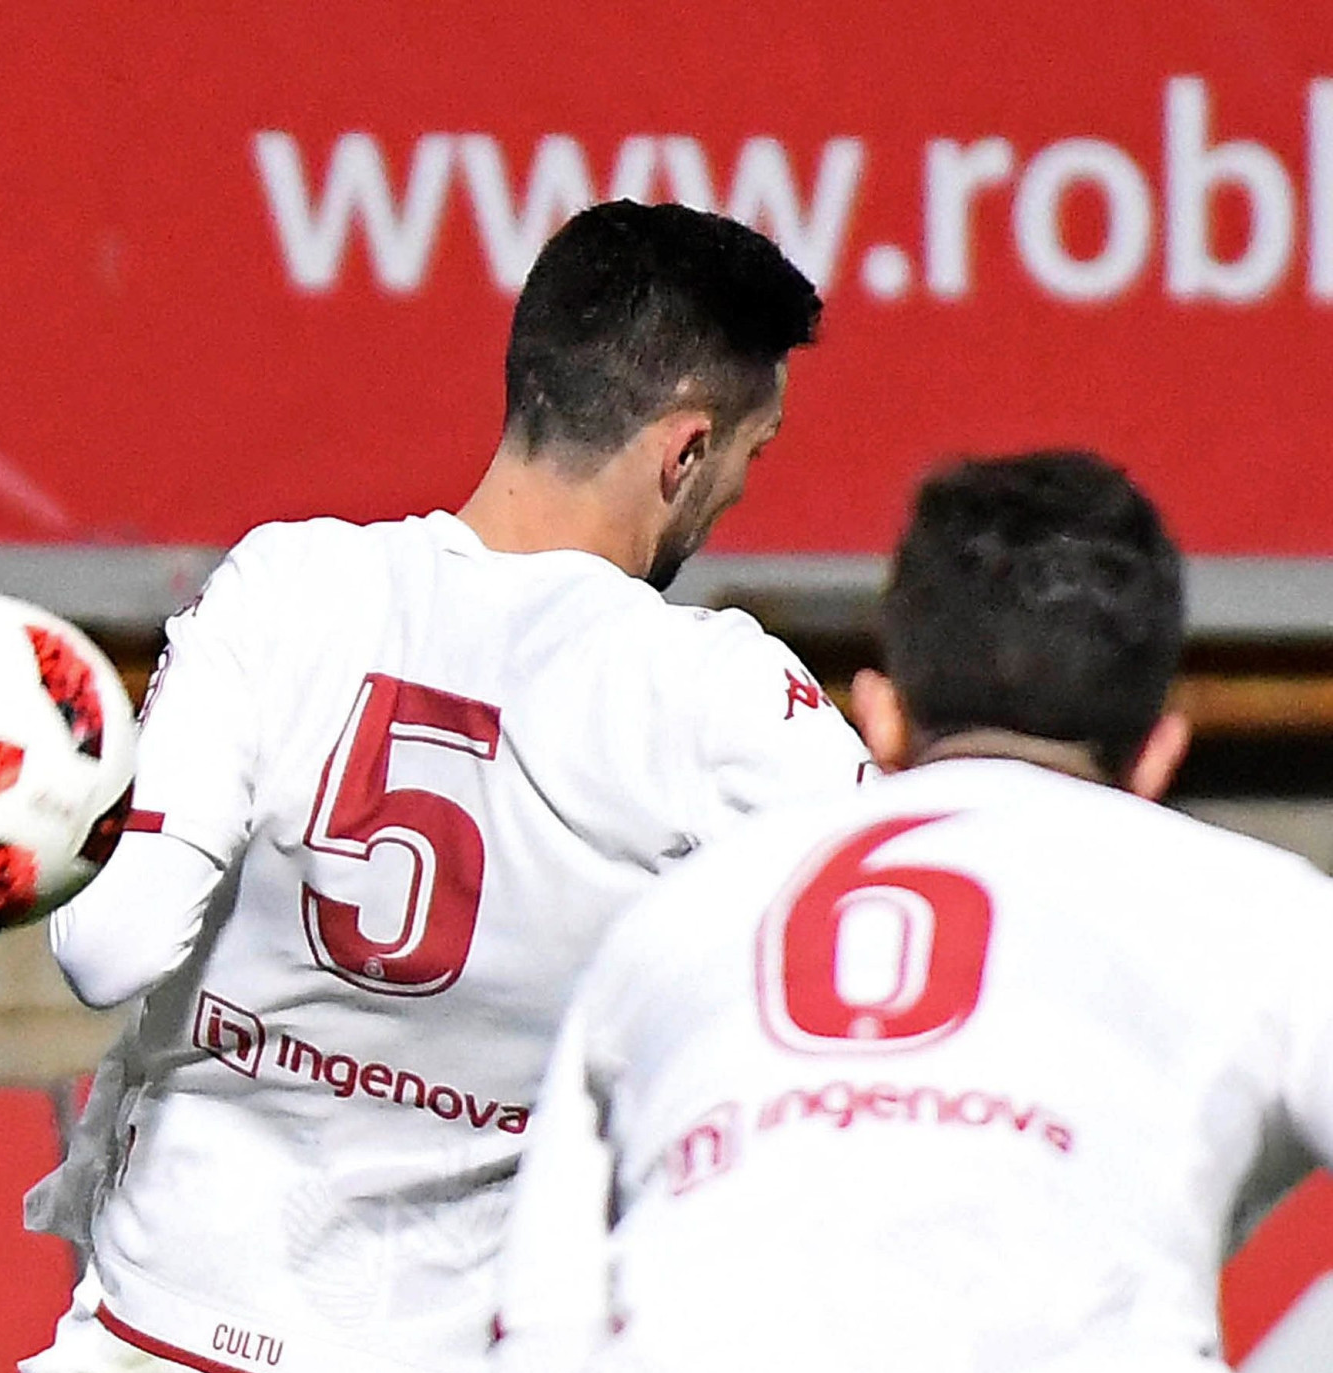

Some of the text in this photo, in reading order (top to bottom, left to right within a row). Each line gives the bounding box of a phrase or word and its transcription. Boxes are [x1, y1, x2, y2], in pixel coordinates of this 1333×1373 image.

[251, 74, 1333, 304] www.rob
[302, 672, 501, 998] 5
[754, 808, 993, 1055] 6
[212, 1322, 284, 1366] CULTU
